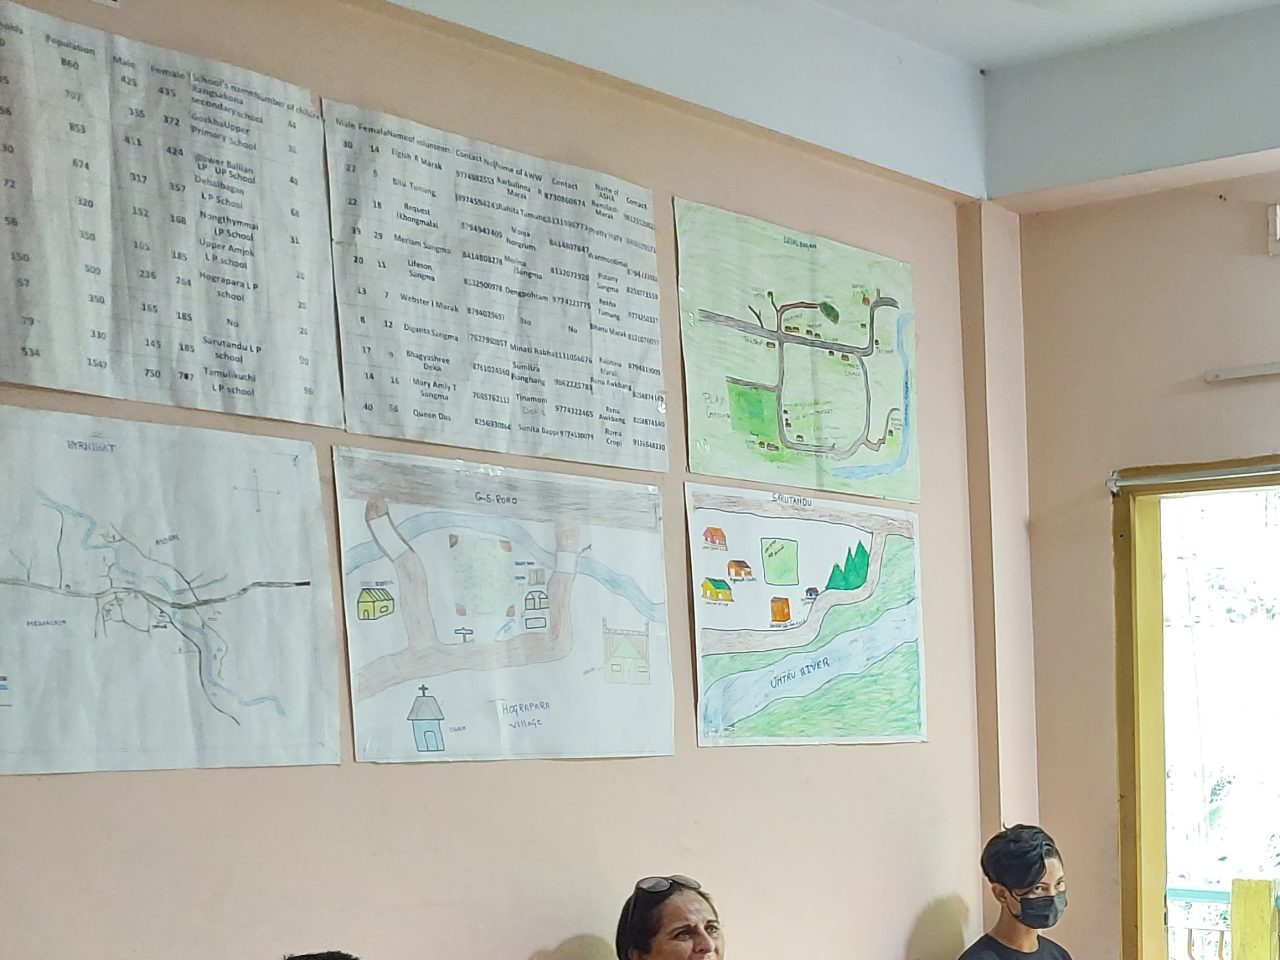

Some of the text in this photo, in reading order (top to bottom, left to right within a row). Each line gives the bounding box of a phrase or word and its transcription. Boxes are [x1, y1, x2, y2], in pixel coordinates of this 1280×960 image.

[45, 33, 96, 56] Population
[112, 55, 136, 69] Male
[150, 65, 184, 80] Female
[61, 57, 80, 70] 860
[120, 75, 138, 88] 425
[158, 86, 177, 98] 435
[163, 114, 181, 127] 372
[336, 118, 355, 130] Male
[69, 122, 86, 134] 853
[343, 140, 353, 149] 30
[369, 145, 380, 153] 14
[166, 146, 185, 157] 424
[72, 159, 89, 171] 674
[346, 163, 356, 173] 27
[455, 149, 483, 163] Contact
[524, 169, 543, 182] AWW
[551, 177, 578, 190] Contact
[130, 172, 147, 184] 317
[197, 162, 256, 185] LP UP School
[169, 182, 186, 193] 357
[506, 188, 528, 201] Marak
[215, 195, 243, 210] School
[132, 206, 149, 218] 152
[169, 214, 187, 225] 168
[80, 230, 96, 241] 350
[214, 227, 254, 241] LP School
[199, 238, 255, 257] Upper Amjok
[11, 252, 30, 263] 150
[172, 250, 188, 261] 185
[219, 256, 248, 270] school
[378, 260, 386, 269] 11
[139, 269, 158, 281] 236
[199, 271, 245, 288] Hograpara
[408, 270, 435, 282] Sangma
[89, 293, 106, 305] 350
[216, 289, 245, 302] school
[400, 292, 460, 314] Webster Marak
[176, 311, 193, 322] 185
[226, 318, 239, 329] No
[383, 320, 393, 329] 12
[567, 325, 578, 334] No
[431, 329, 459, 342] Sangma
[145, 338, 162, 350] 145
[179, 343, 196, 354] 185
[202, 335, 248, 351] Sarutandu
[509, 343, 533, 354] Minati
[20, 346, 41, 358] 534
[362, 346, 372, 355] 17
[214, 350, 244, 364] school
[87, 358, 108, 369] 1547
[423, 362, 442, 372] Deka
[144, 368, 161, 380] 750
[364, 371, 375, 381] 14
[412, 376, 431, 389] Mary
[226, 386, 255, 398] school
[420, 389, 449, 401] Sangma
[363, 402, 374, 412] 40
[413, 408, 453, 421] Queen Das
[799, 656, 831, 677] RIVER
